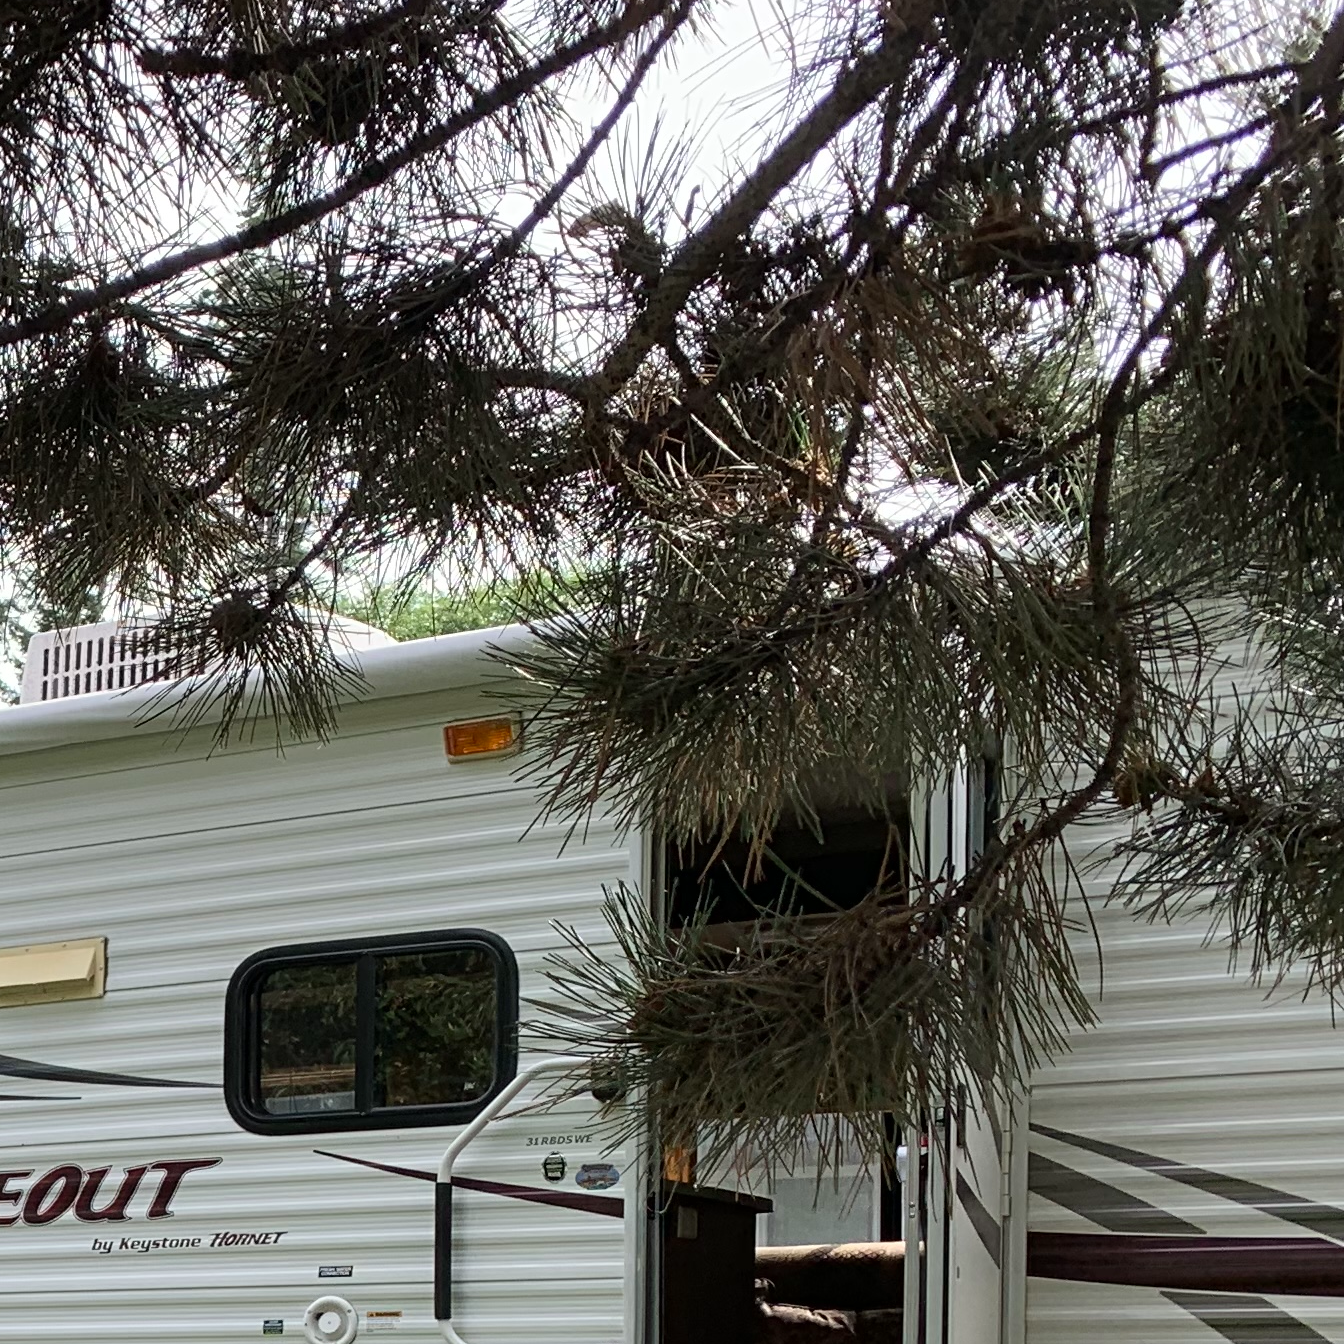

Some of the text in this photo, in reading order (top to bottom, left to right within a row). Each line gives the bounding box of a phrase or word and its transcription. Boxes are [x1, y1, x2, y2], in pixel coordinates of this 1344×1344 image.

[91, 1231, 288, 1254] by Keystone HORNET
